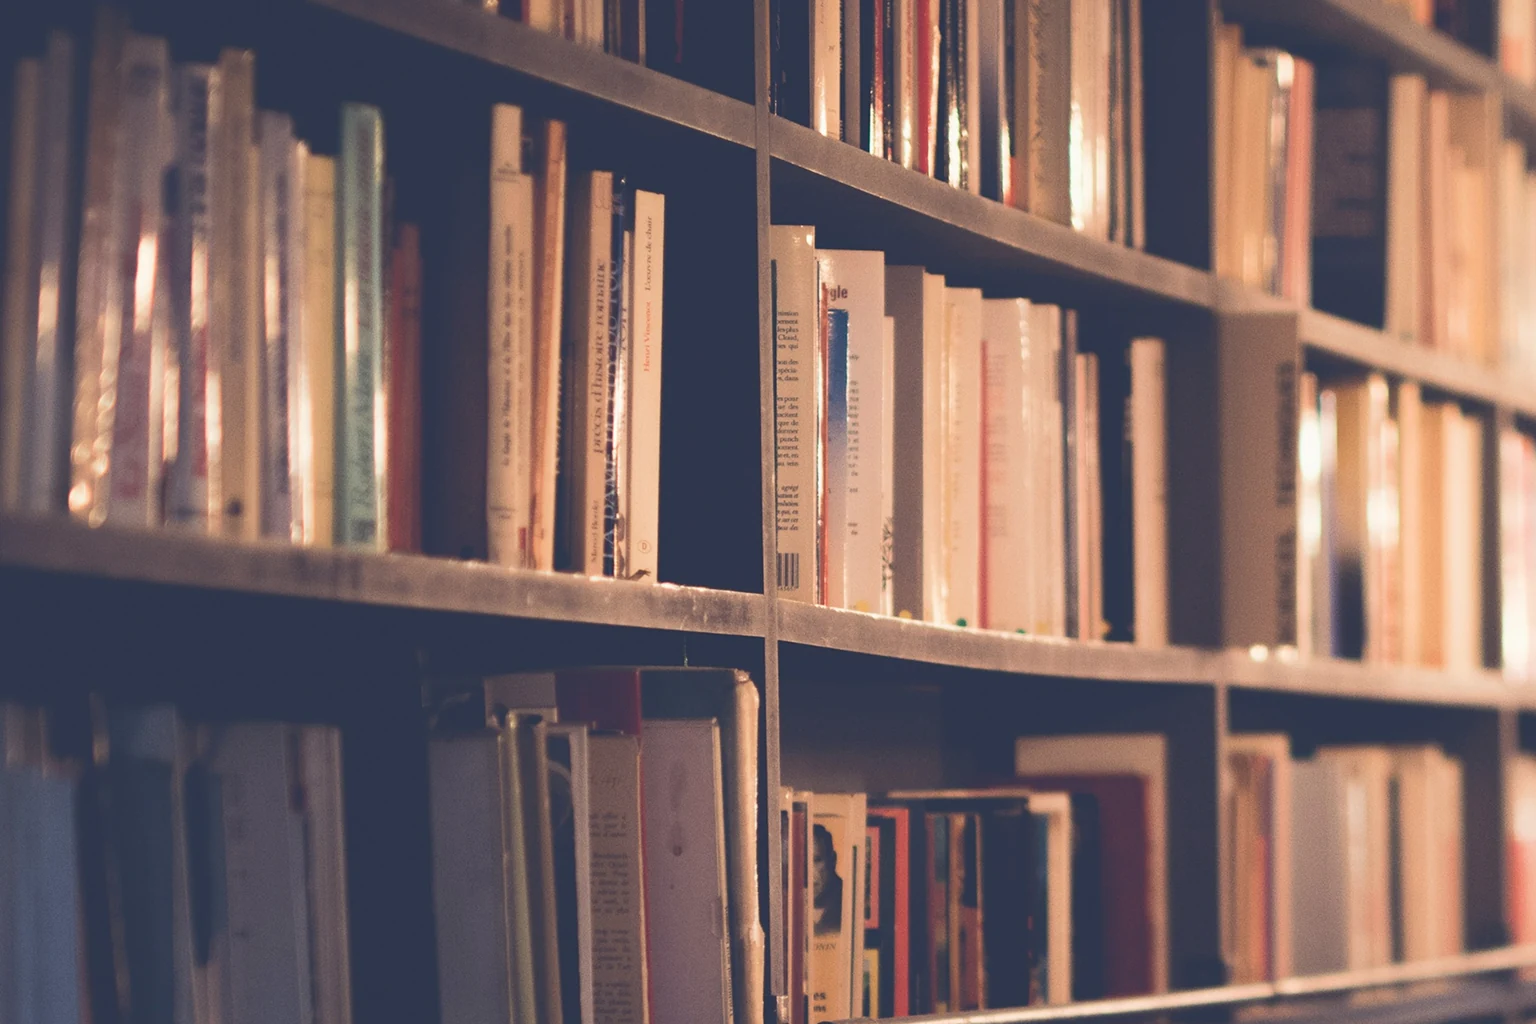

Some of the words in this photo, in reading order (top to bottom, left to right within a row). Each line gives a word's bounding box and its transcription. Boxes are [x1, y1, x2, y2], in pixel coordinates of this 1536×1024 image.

[644, 215, 652, 240] chair
[645, 241, 652, 253] de
[593, 260, 605, 326] romaine
[643, 300, 651, 343] Vincenot
[590, 329, 604, 403] d'histoire
[643, 344, 651, 373] Henri
[591, 407, 604, 454] précis
